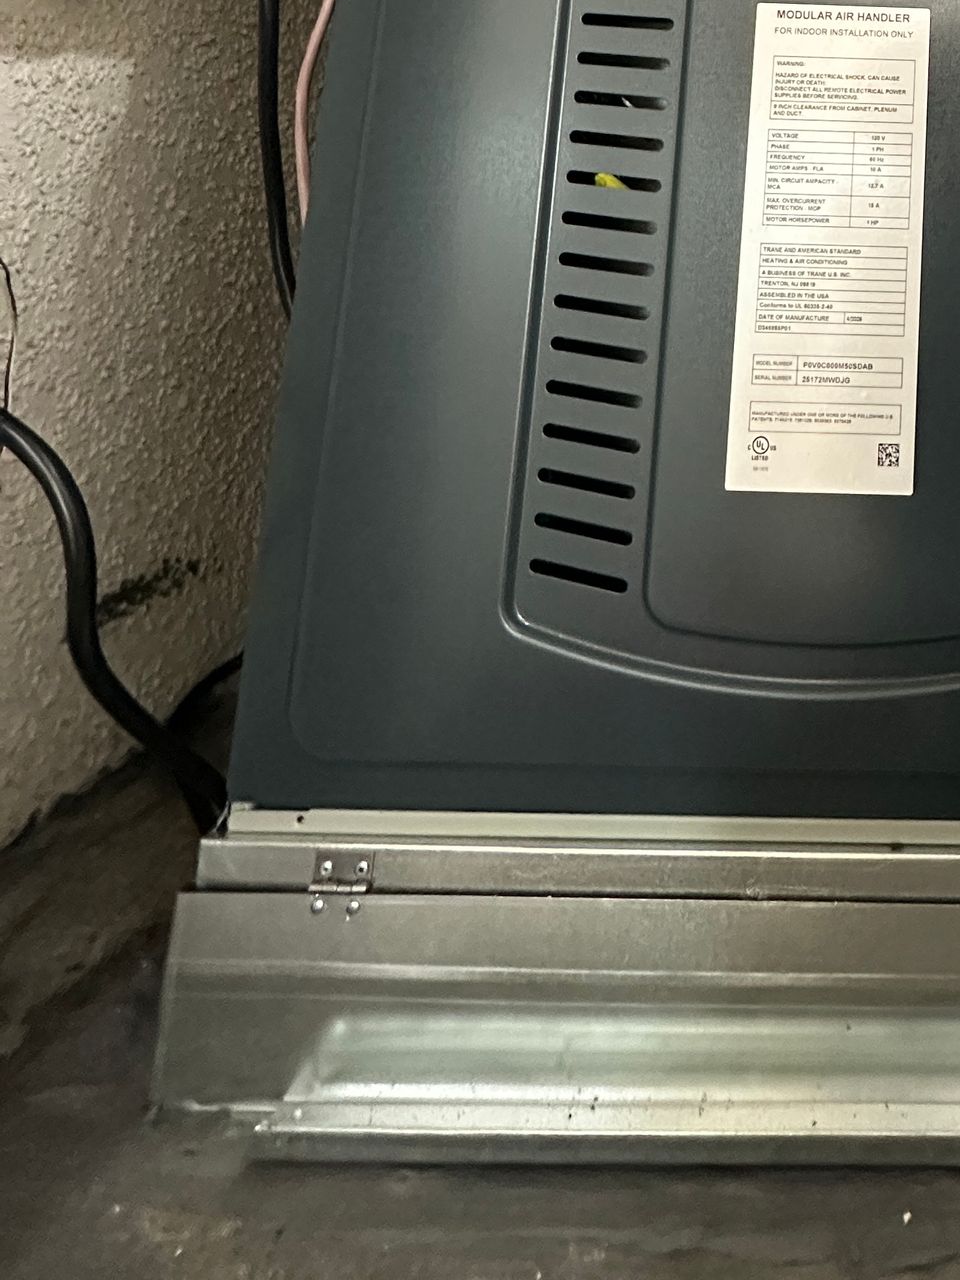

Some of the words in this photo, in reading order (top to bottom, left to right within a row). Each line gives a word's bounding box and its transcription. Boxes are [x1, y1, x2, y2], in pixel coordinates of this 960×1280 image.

[777, 10, 833, 21] MODULAR
[835, 12, 854, 21] AIR
[857, 12, 911, 23] HANDLER
[774, 27, 792, 35] FOR
[794, 27, 828, 36] INDOOR
[830, 28, 889, 38] INSTALLATION
[891, 30, 914, 39] ONLY
